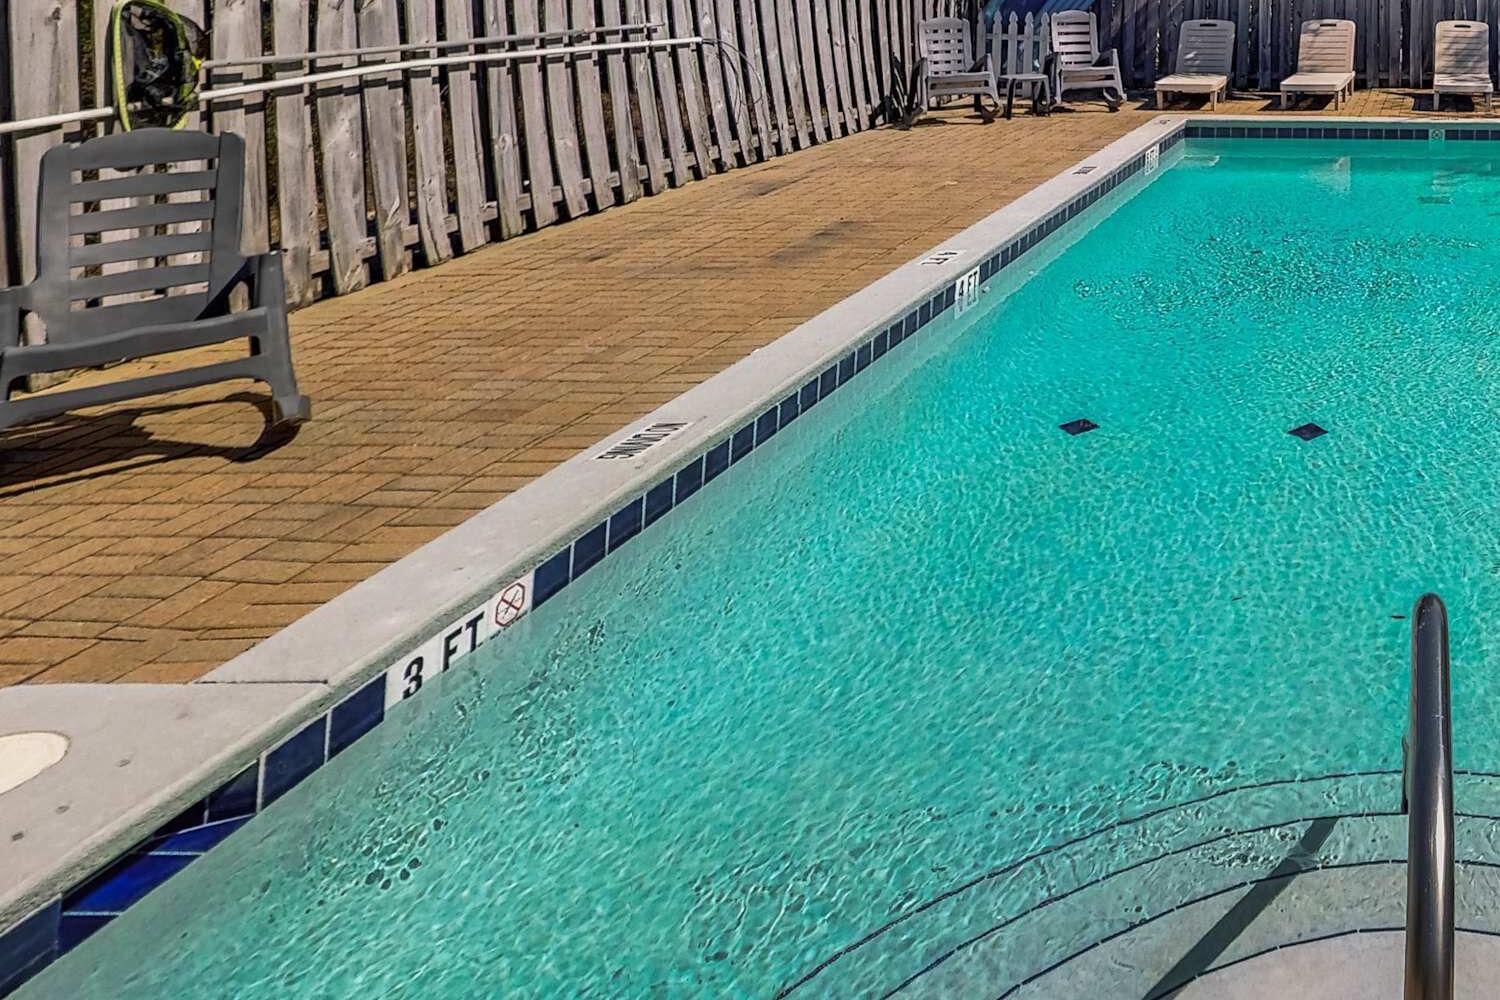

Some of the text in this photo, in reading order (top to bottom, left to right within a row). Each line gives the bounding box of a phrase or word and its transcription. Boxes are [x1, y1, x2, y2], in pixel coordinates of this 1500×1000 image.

[958, 279, 965, 297] 4
[402, 611, 485, 700] 3 FT
